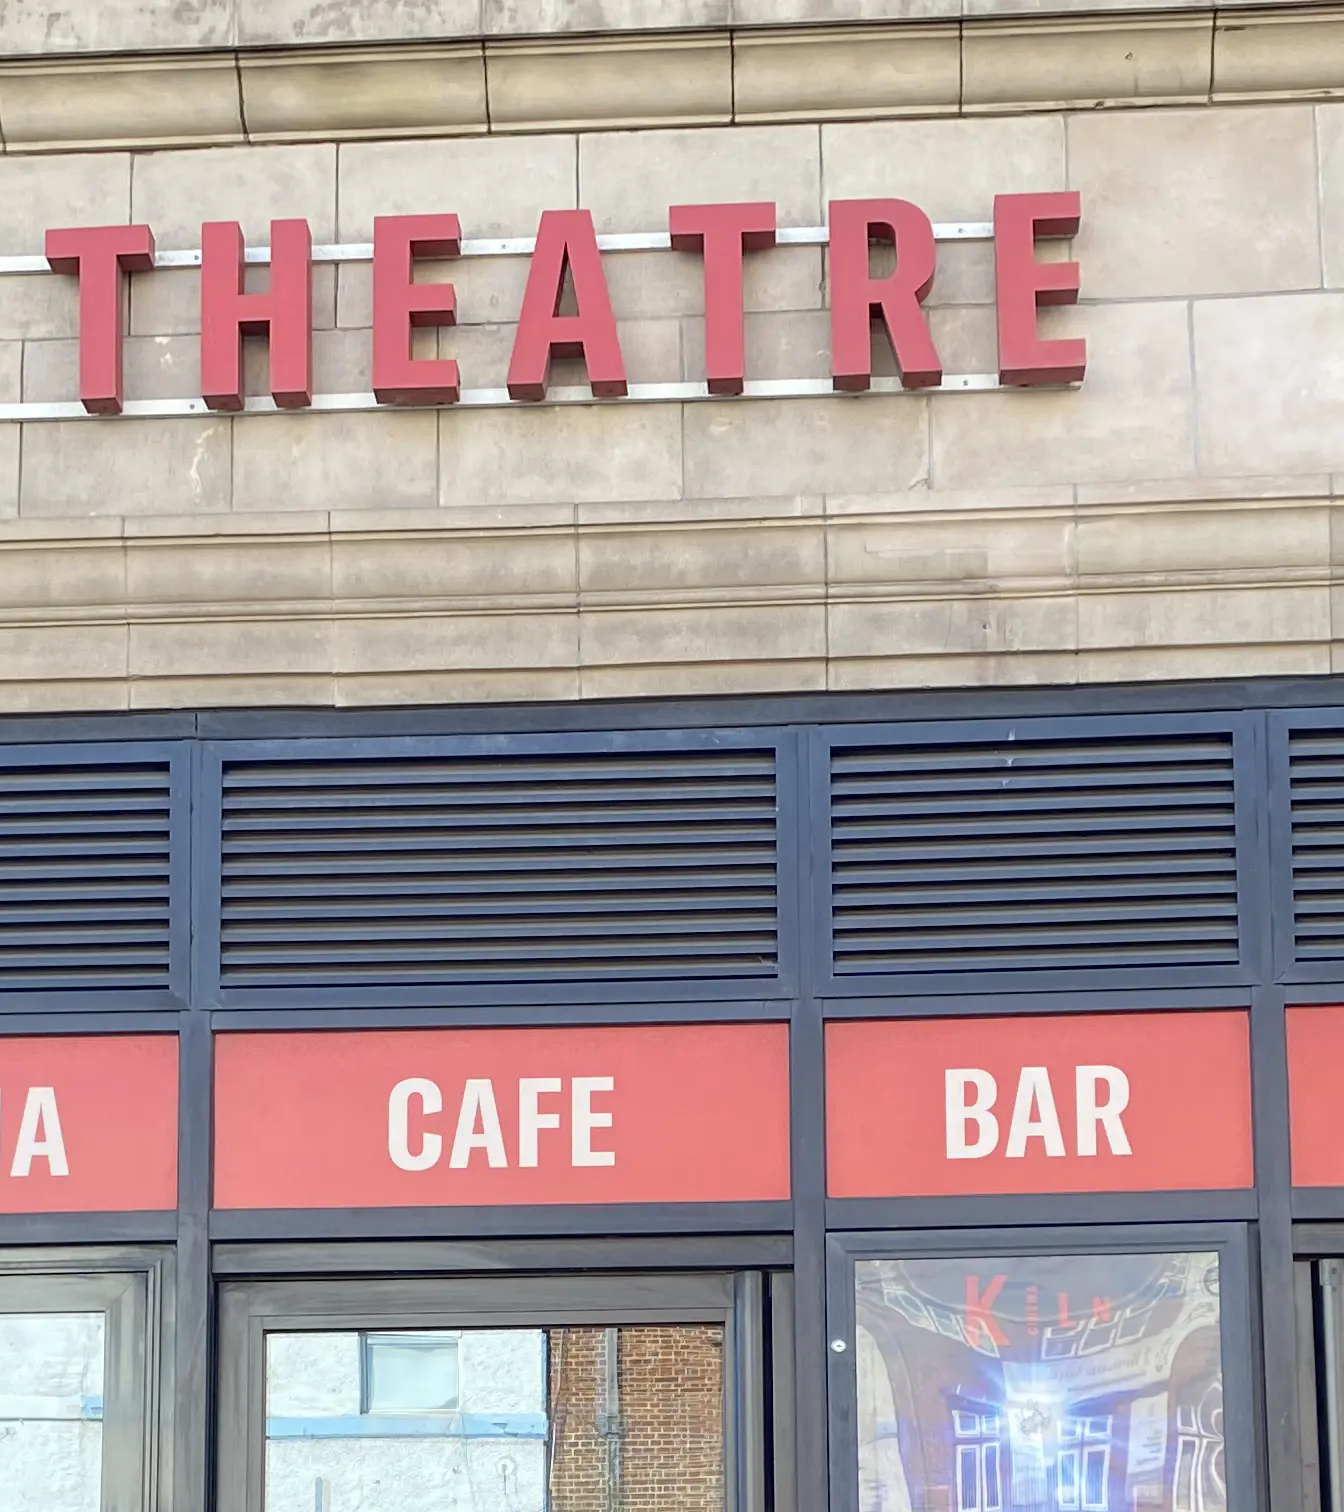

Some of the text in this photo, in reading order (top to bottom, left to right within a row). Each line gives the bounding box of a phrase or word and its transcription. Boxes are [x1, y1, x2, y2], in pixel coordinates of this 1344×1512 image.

[45, 190, 1087, 415] THEATRE
[388, 1076, 615, 1171] CAFE
[944, 1064, 1133, 1160] BAR
